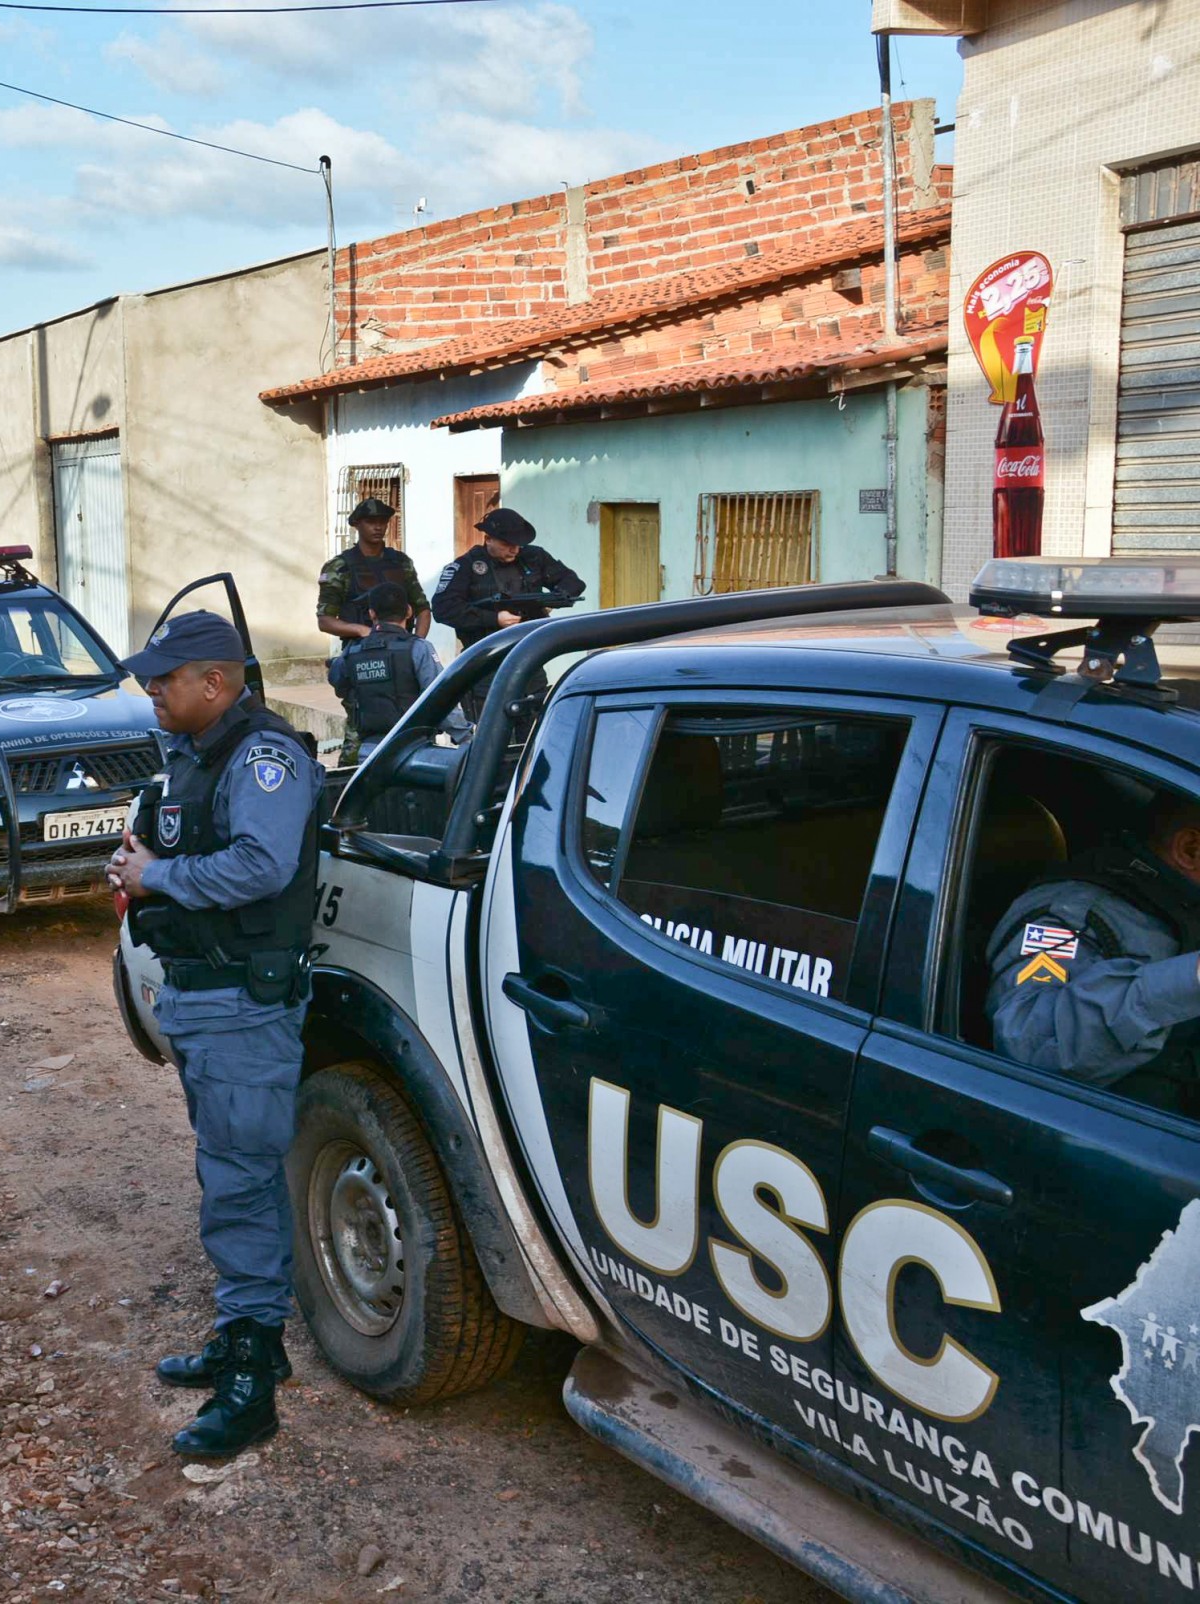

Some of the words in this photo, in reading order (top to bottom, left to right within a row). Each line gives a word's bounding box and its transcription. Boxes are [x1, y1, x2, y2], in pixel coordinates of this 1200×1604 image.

[966, 290, 981, 315] Mais
[979, 259, 1020, 290] economia
[997, 455, 1040, 478] Coca-Cola
[356, 660, 386, 671] POLÍCIA
[356, 669, 387, 680] MILITAR
[34, 734, 49, 745] DE
[50, 729, 110, 742] OPERAÇÕES
[722, 935, 833, 998] MILITAR
[588, 1076, 1002, 1424] USC
[591, 1246, 712, 1335] UNIDADE
[719, 1316, 761, 1362] DE
[769, 1344, 1000, 1489] SEGURANÇA
[793, 1399, 878, 1466] VILA
[883, 1448, 1033, 1551] LUIZÃO
